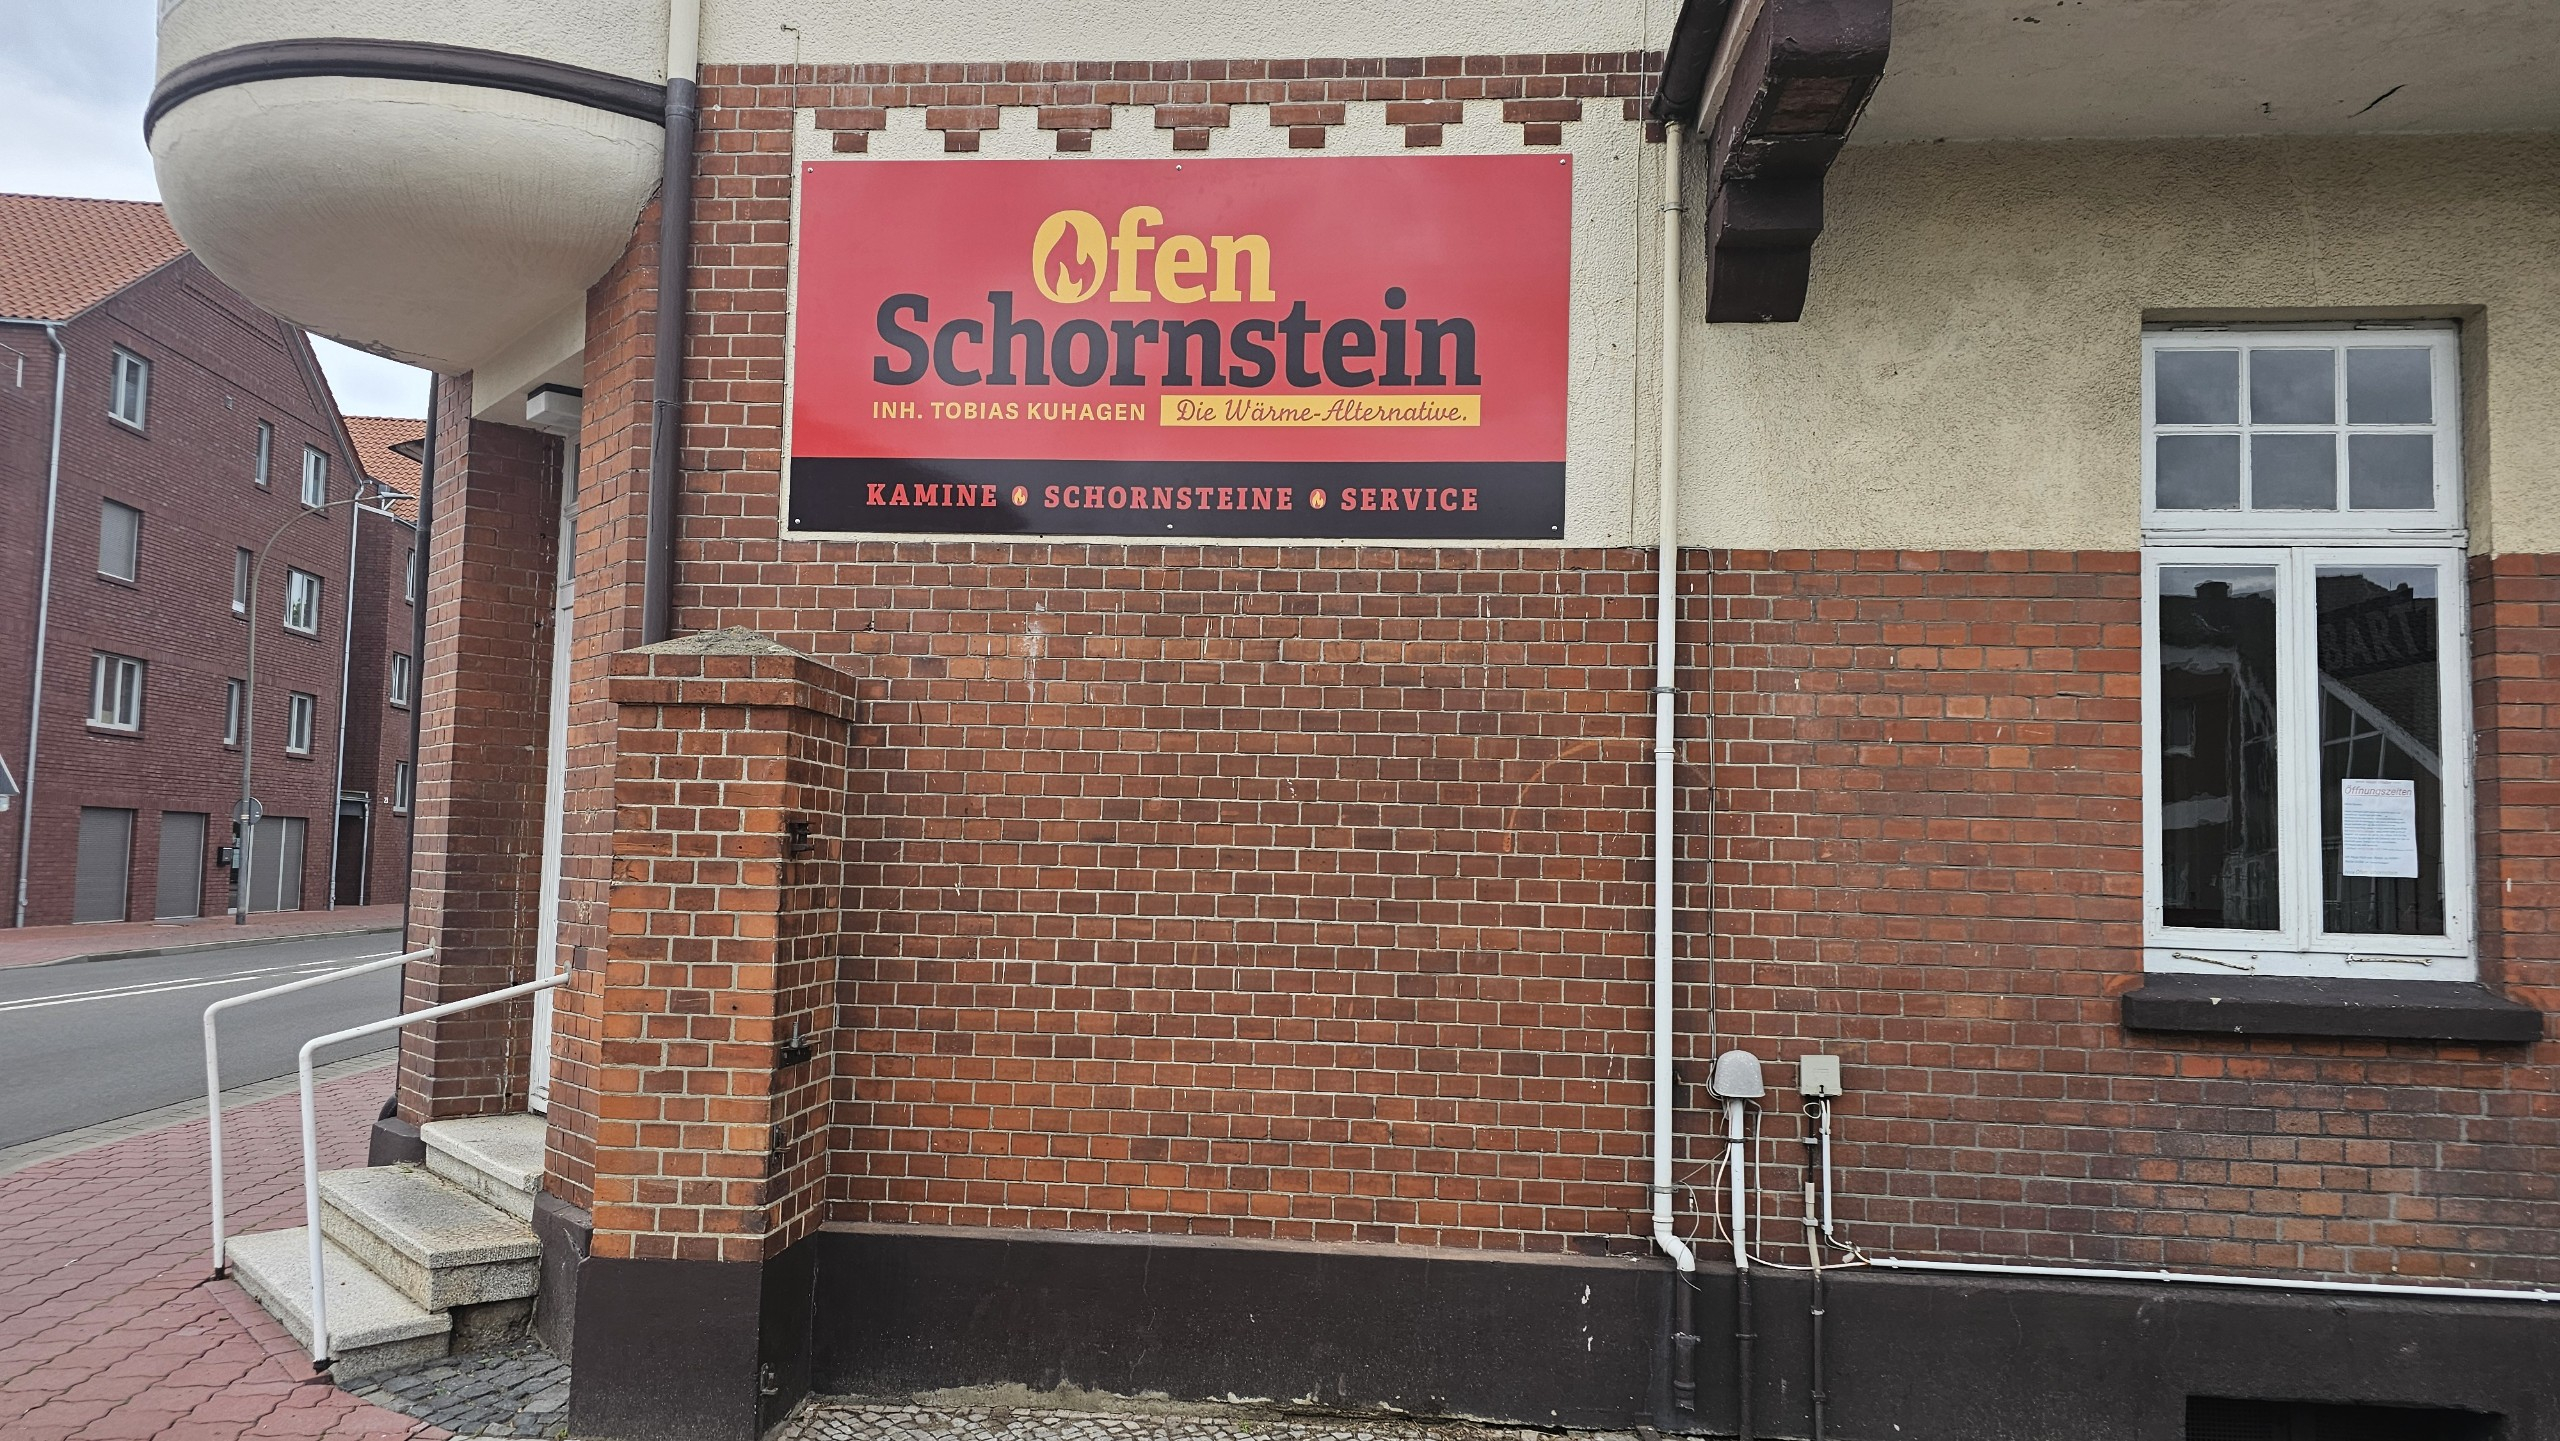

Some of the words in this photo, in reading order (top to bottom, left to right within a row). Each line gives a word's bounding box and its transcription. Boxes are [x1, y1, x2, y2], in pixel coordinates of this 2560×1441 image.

[1032, 205, 1276, 304] Ofen
[874, 286, 1482, 389] Schornstein
[872, 401, 924, 420] INH.
[930, 401, 1020, 421] TOBIAS
[1027, 401, 1146, 422] KUHAGEN
[1176, 399, 1218, 422] Die
[1225, 398, 1468, 423] Wärme-Alternative.
[866, 483, 998, 509] KAMINE
[1044, 485, 1293, 511] SCHORNSTEINE
[1341, 487, 1479, 512] SERVICE
[2344, 785, 2412, 797] Öffnungszeiten
